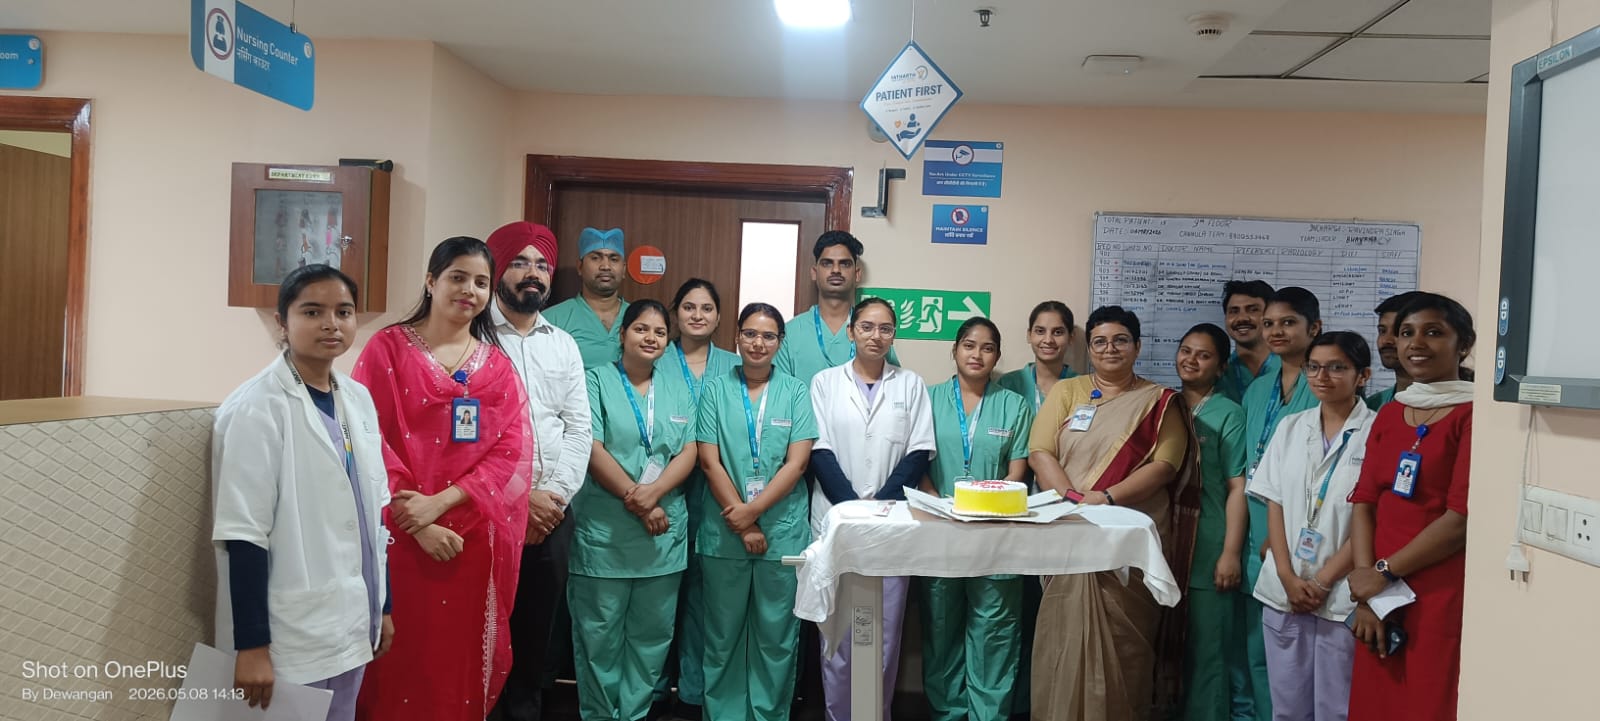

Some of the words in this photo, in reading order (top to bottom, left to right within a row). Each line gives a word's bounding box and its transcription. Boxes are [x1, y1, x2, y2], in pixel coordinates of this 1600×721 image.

[236, 26, 269, 55] Nursing
[269, 43, 298, 65] Counter
[875, 87, 913, 101] PATIENT
[915, 84, 943, 96] FIRST
